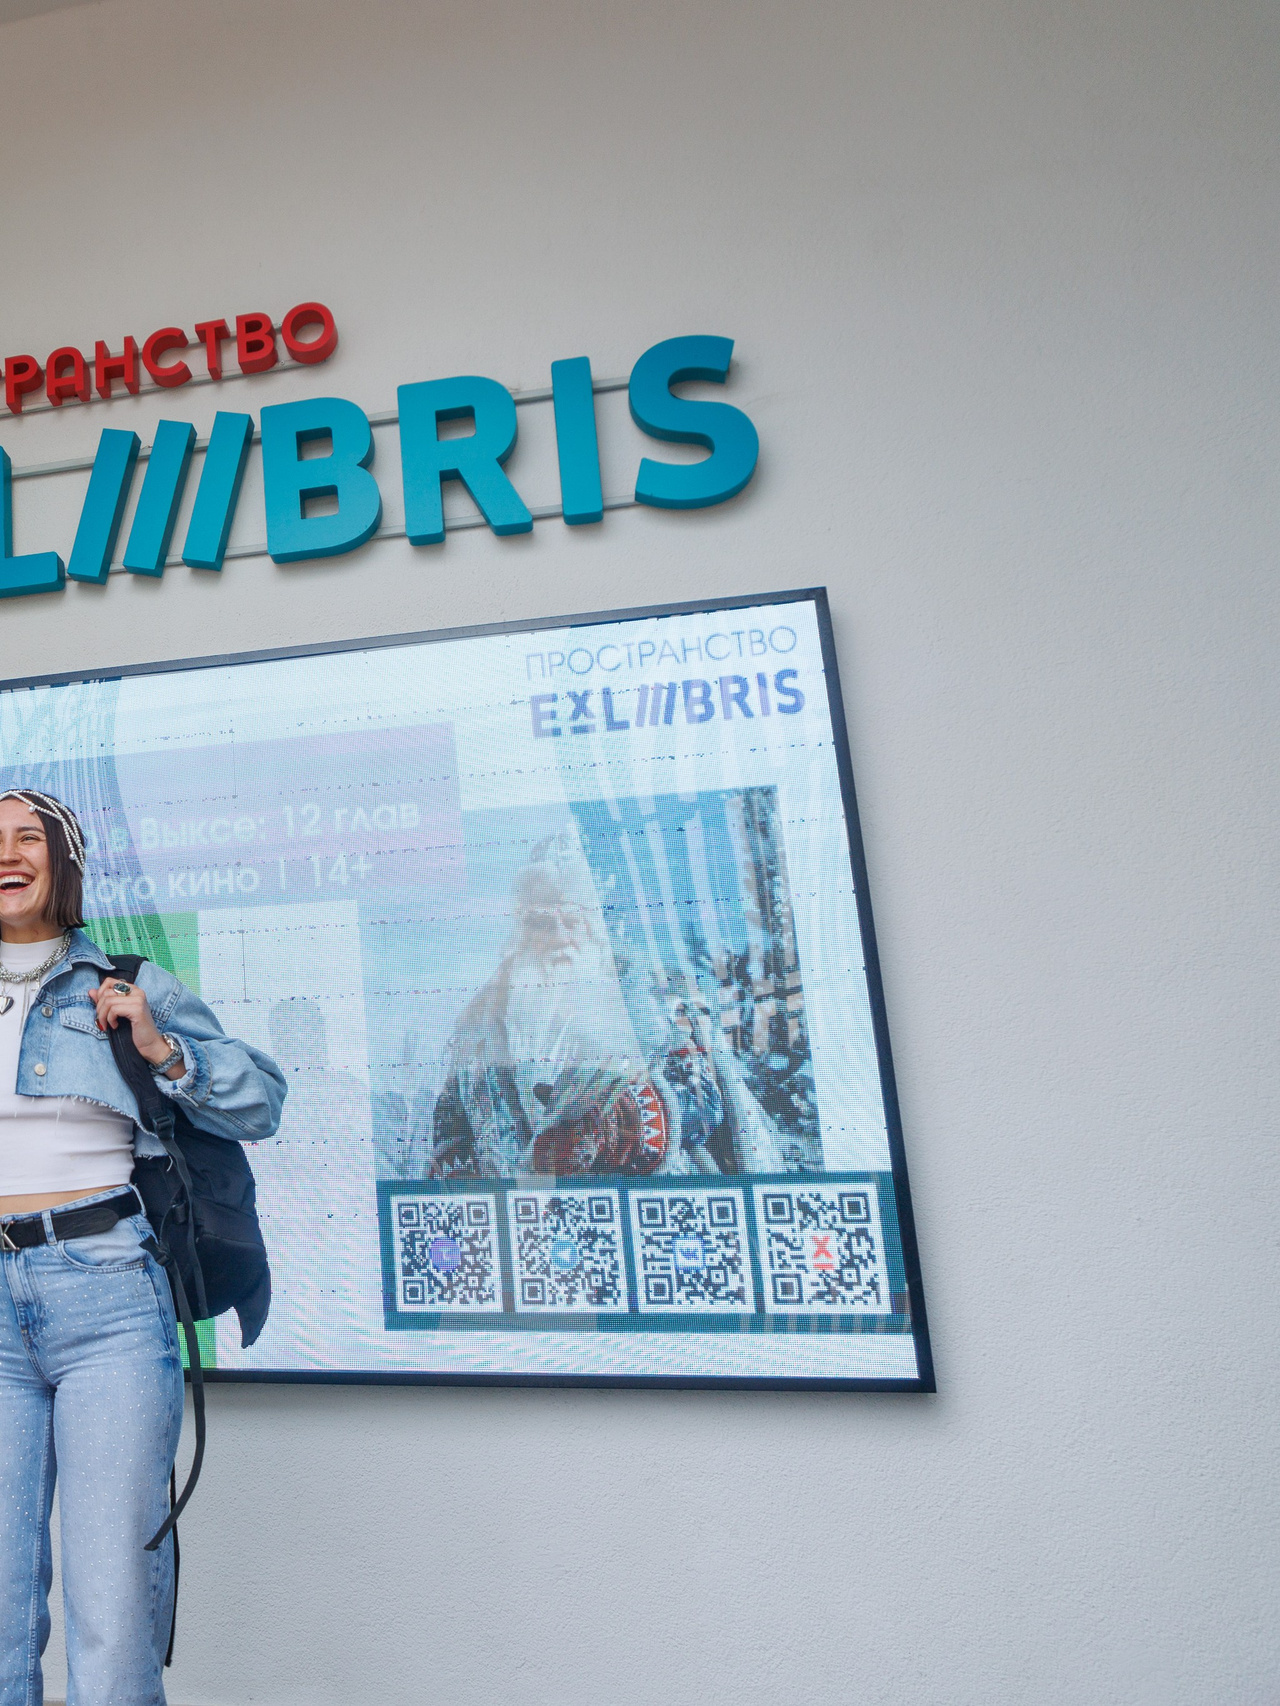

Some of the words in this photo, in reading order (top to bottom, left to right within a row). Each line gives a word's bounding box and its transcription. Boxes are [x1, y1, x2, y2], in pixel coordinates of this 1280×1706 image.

[526, 625, 797, 680] ПРОСТРАНСТВО
[140, 816, 266, 850] Выксе:
[283, 803, 321, 837] 12
[333, 802, 420, 834] глав
[168, 868, 260, 898] кино
[311, 850, 373, 888] 14+
